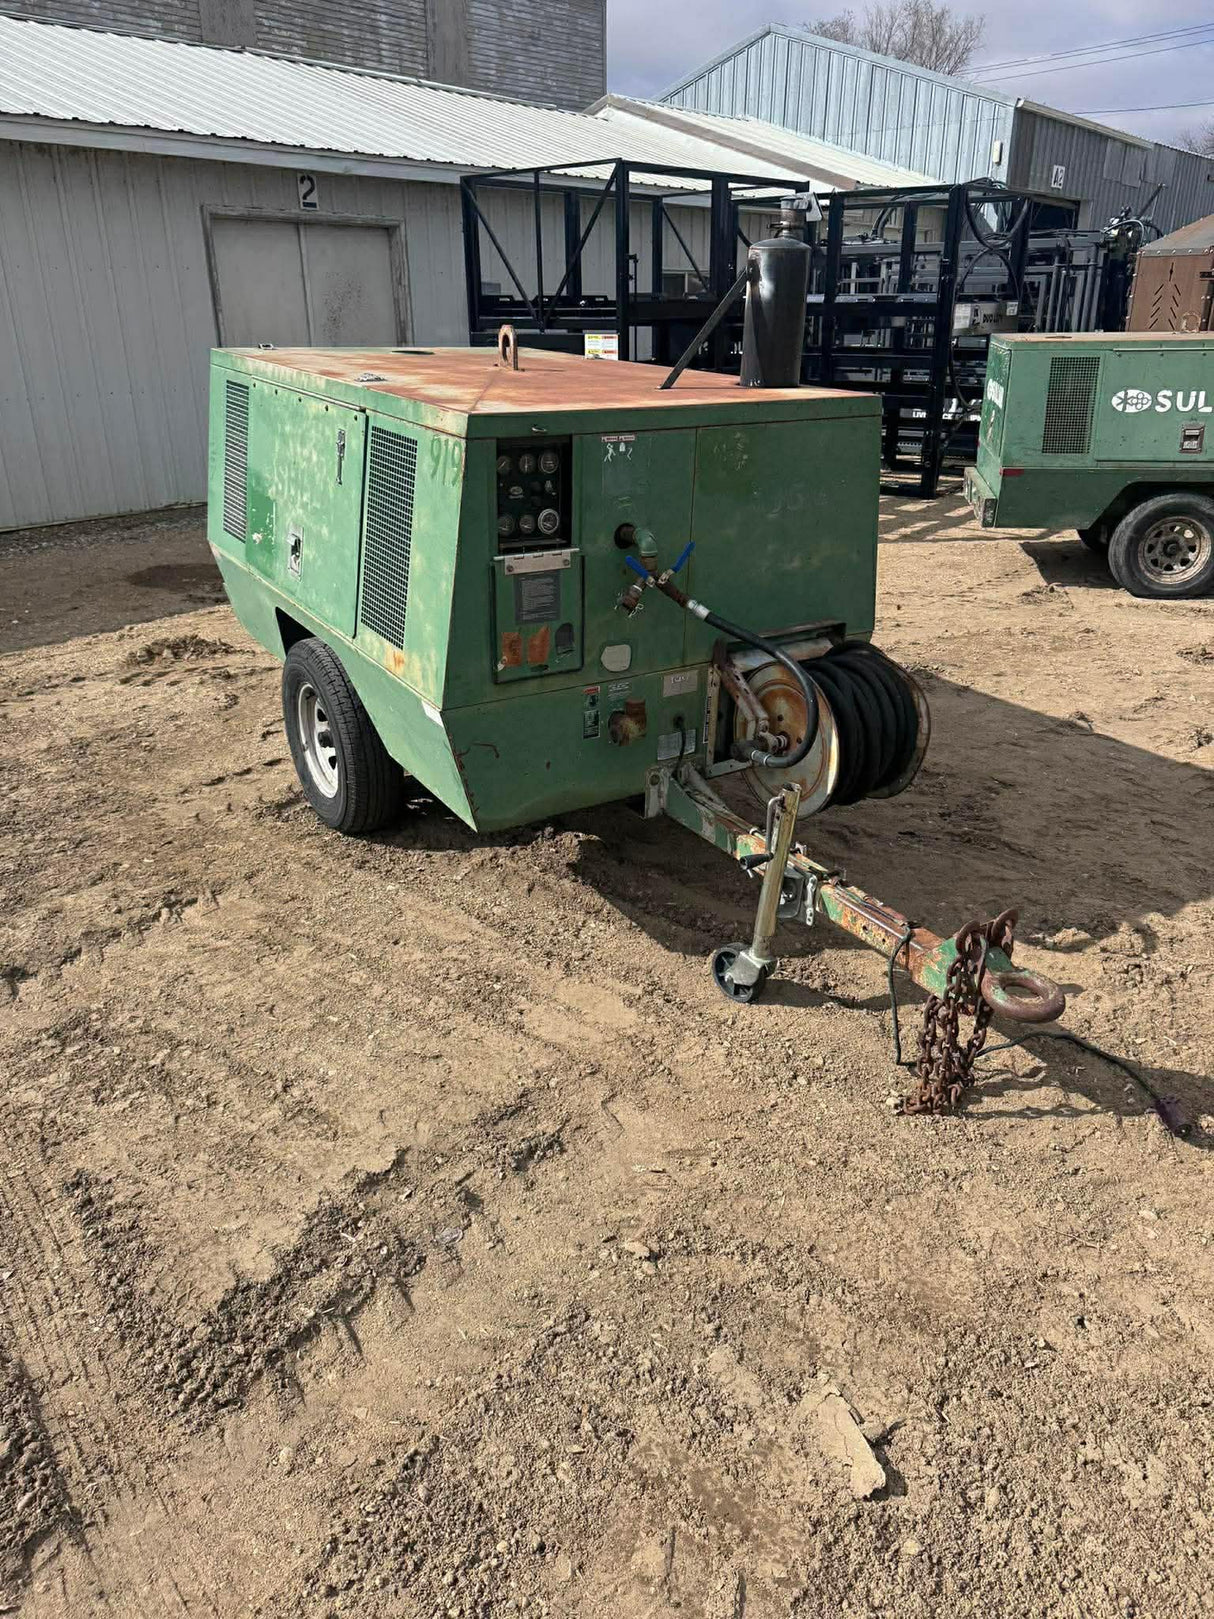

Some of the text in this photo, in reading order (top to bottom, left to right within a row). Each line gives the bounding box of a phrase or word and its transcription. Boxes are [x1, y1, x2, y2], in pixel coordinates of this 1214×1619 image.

[300, 174, 317, 208] 2
[1155, 389, 1213, 413] SUL
[430, 433, 463, 487] 919
